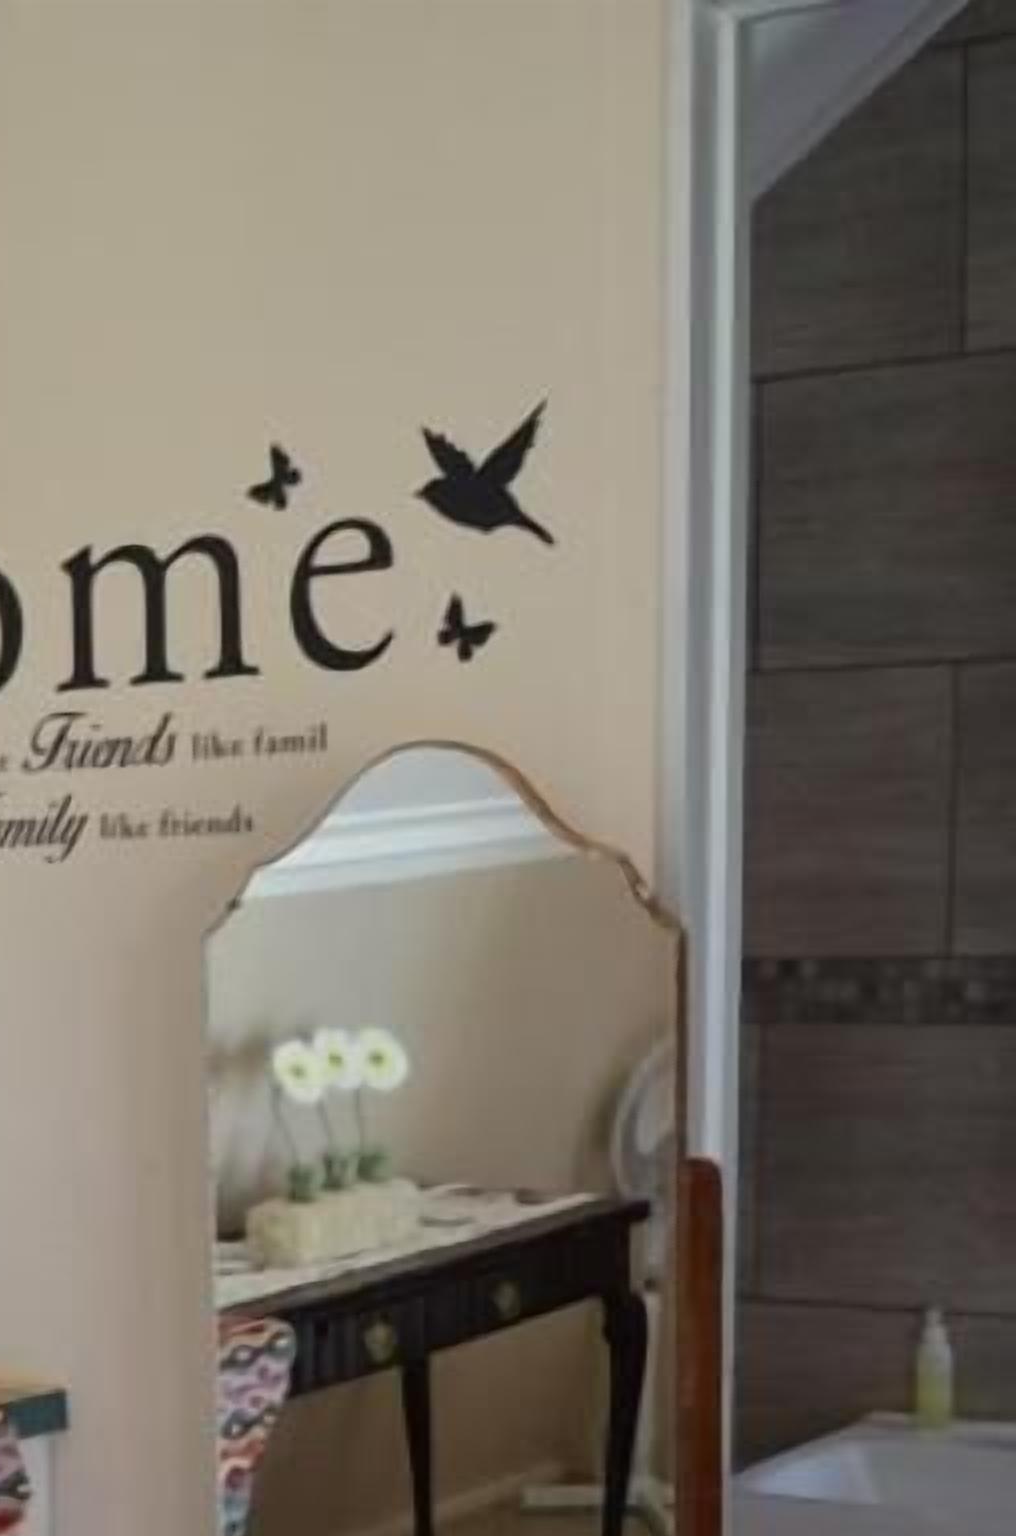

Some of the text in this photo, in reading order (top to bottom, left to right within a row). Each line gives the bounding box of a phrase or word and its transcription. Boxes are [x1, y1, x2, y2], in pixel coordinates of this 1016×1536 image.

[21, 711, 176, 774] Friends
[190, 730, 243, 762] like
[100, 811, 149, 840] like
[157, 803, 253, 838] friends
